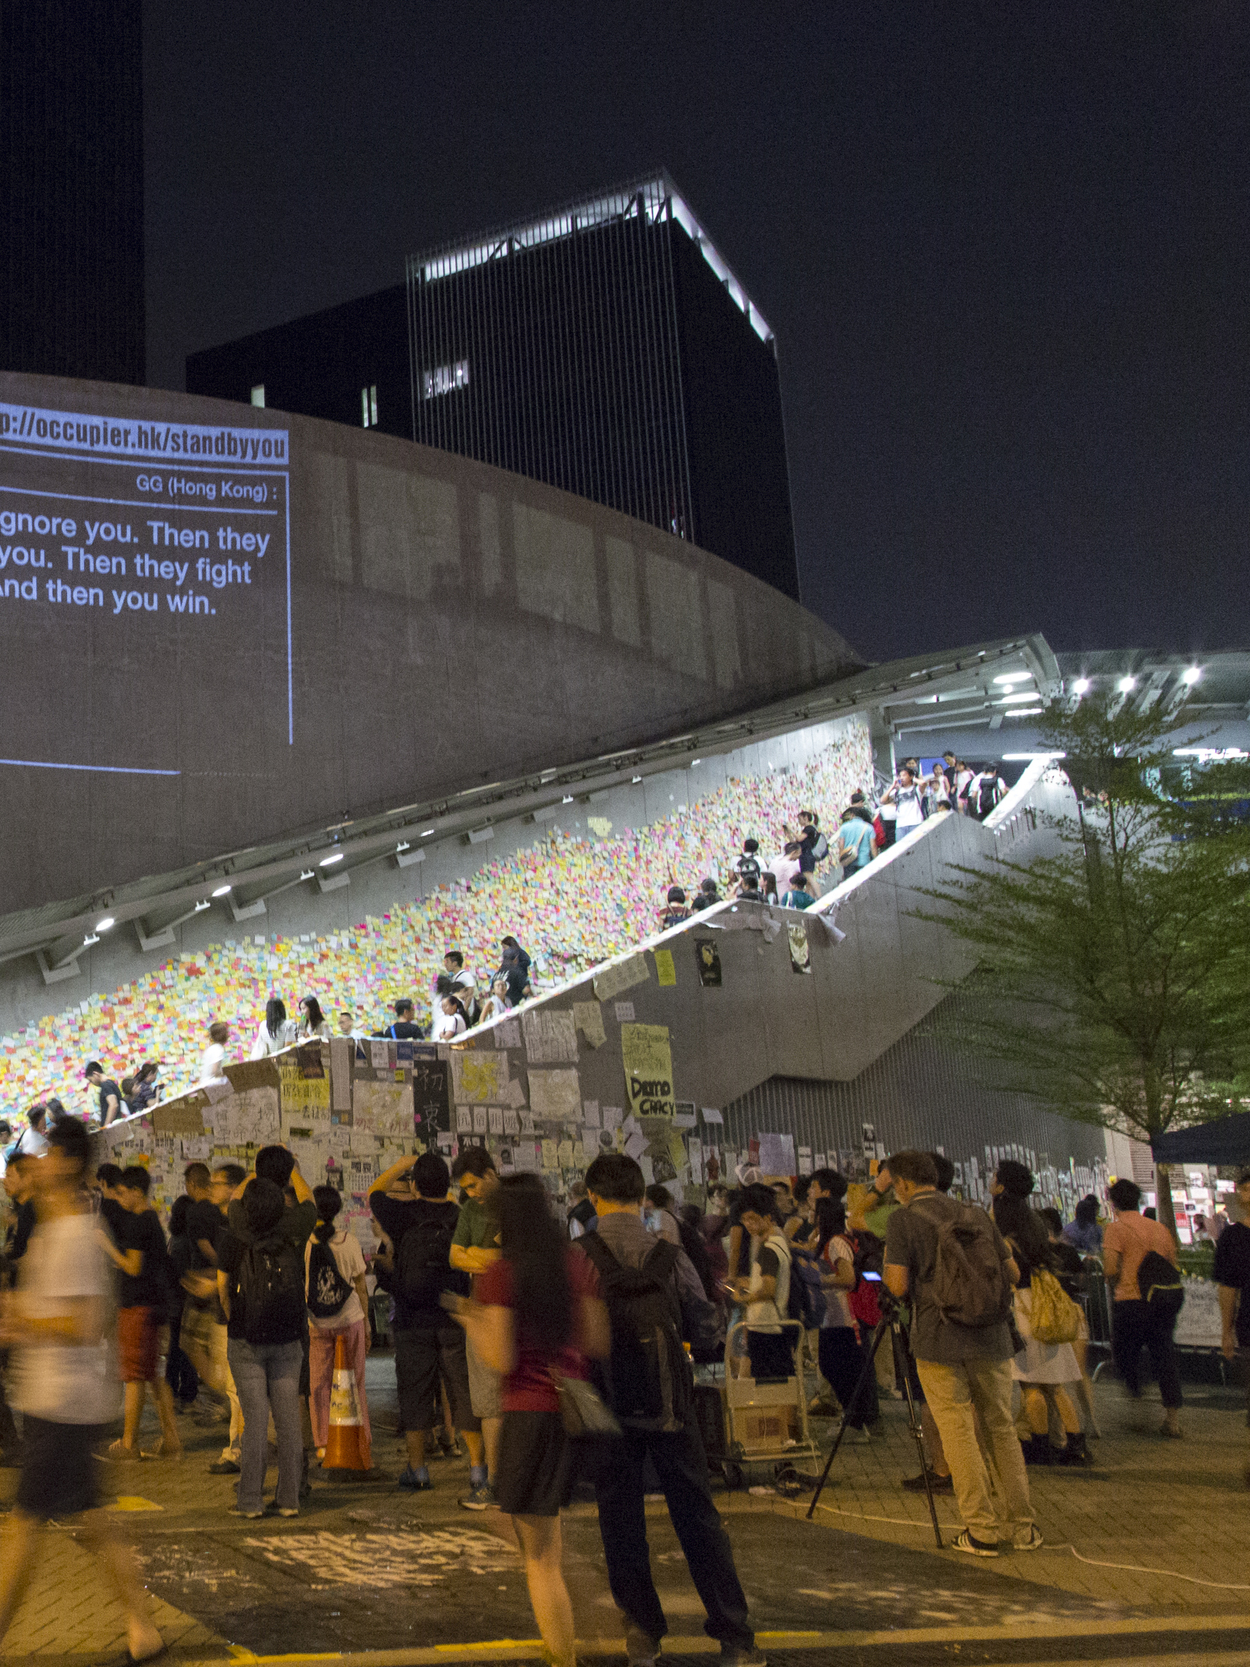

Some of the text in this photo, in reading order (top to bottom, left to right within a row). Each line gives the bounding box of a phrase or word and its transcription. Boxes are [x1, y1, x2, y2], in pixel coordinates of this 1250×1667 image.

[136, 474, 163, 493] GG
[168, 475, 217, 500] (Hong
[84, 519, 140, 545] you.
[147, 520, 209, 548] Then
[217, 527, 271, 557] they
[61, 545, 126, 575] Then
[134, 553, 189, 586] they
[196, 558, 252, 588] fight
[45, 579, 104, 606] then
[112, 589, 158, 614] you
[166, 590, 217, 615] win.
